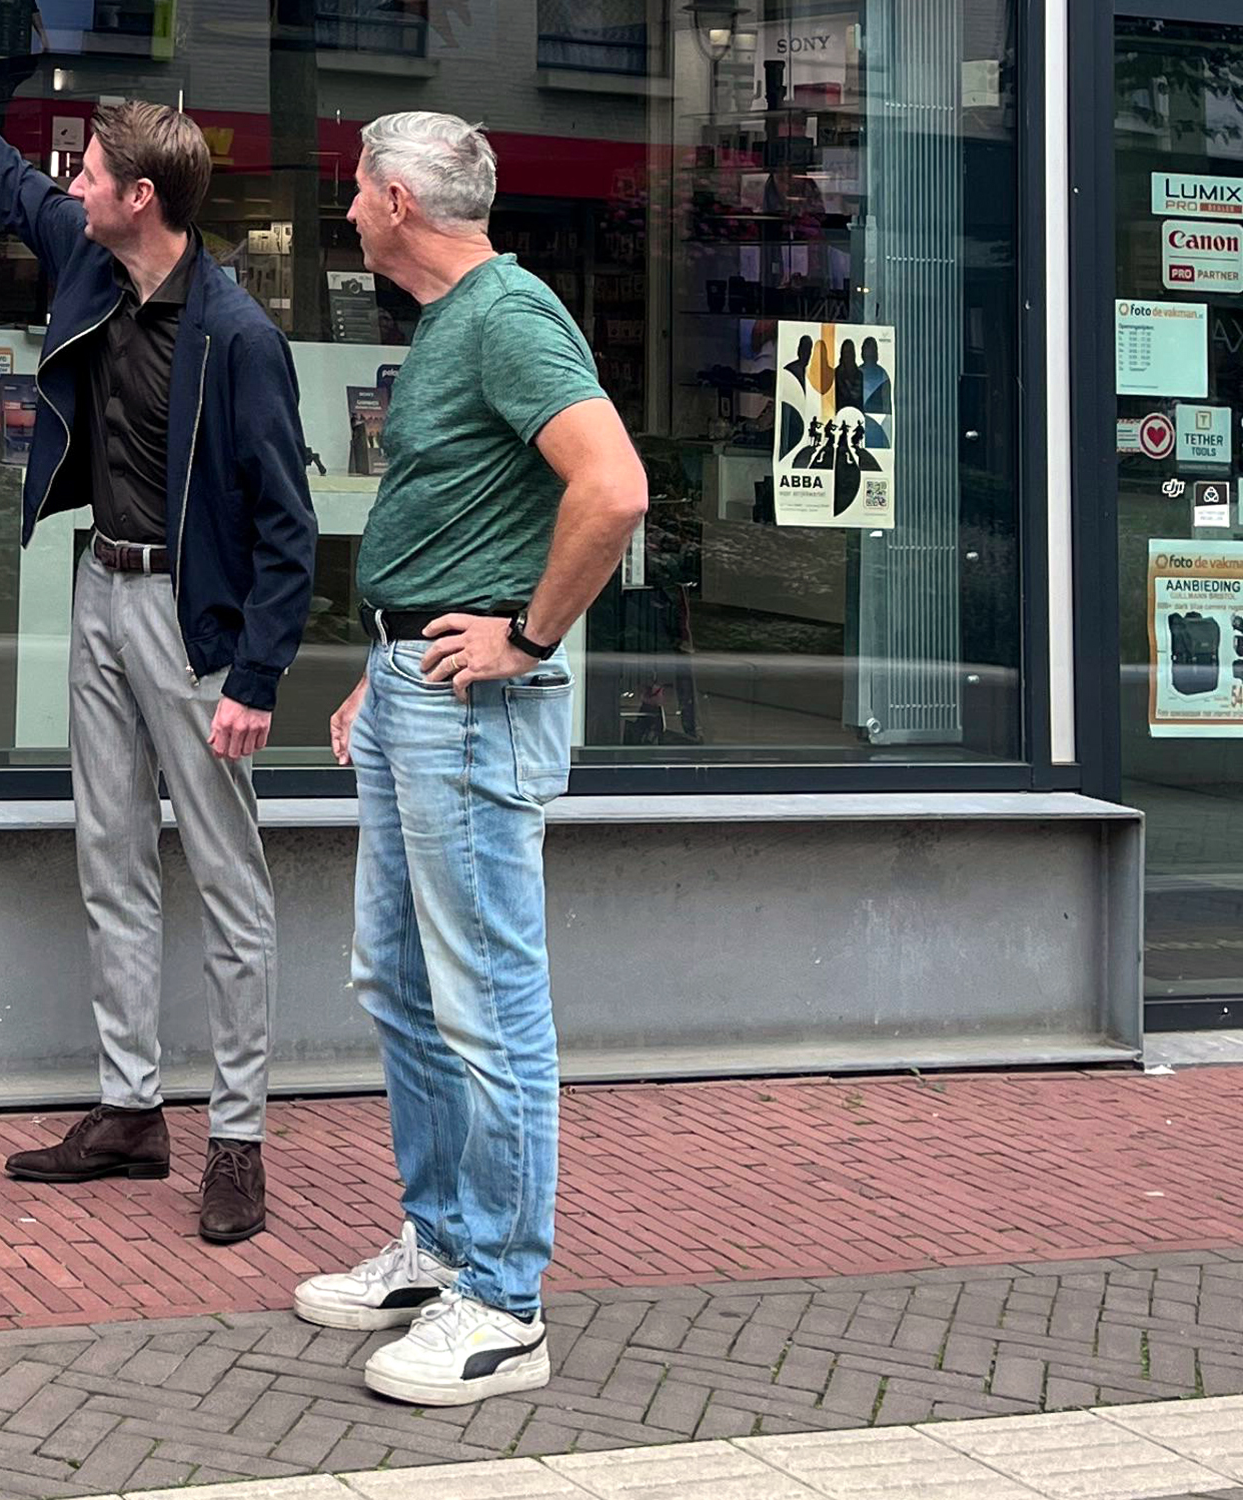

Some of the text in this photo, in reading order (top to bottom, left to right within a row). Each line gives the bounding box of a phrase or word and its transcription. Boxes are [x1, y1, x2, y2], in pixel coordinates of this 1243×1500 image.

[777, 35, 830, 54] SONY
[1165, 178, 1243, 202] LUMIX
[1165, 200, 1198, 212] PRO
[1168, 230, 1239, 252] Canon
[1171, 268, 1239, 281] PRO PARTNER
[1130, 303, 1152, 317] foto
[1184, 432, 1224, 447] TETHER
[1191, 447, 1217, 457] TOOLS
[779, 475, 823, 489] ABBA
[1169, 554, 1193, 568] foto
[1194, 556, 1209, 569] de
[1166, 579, 1241, 593] AANBIEDING
